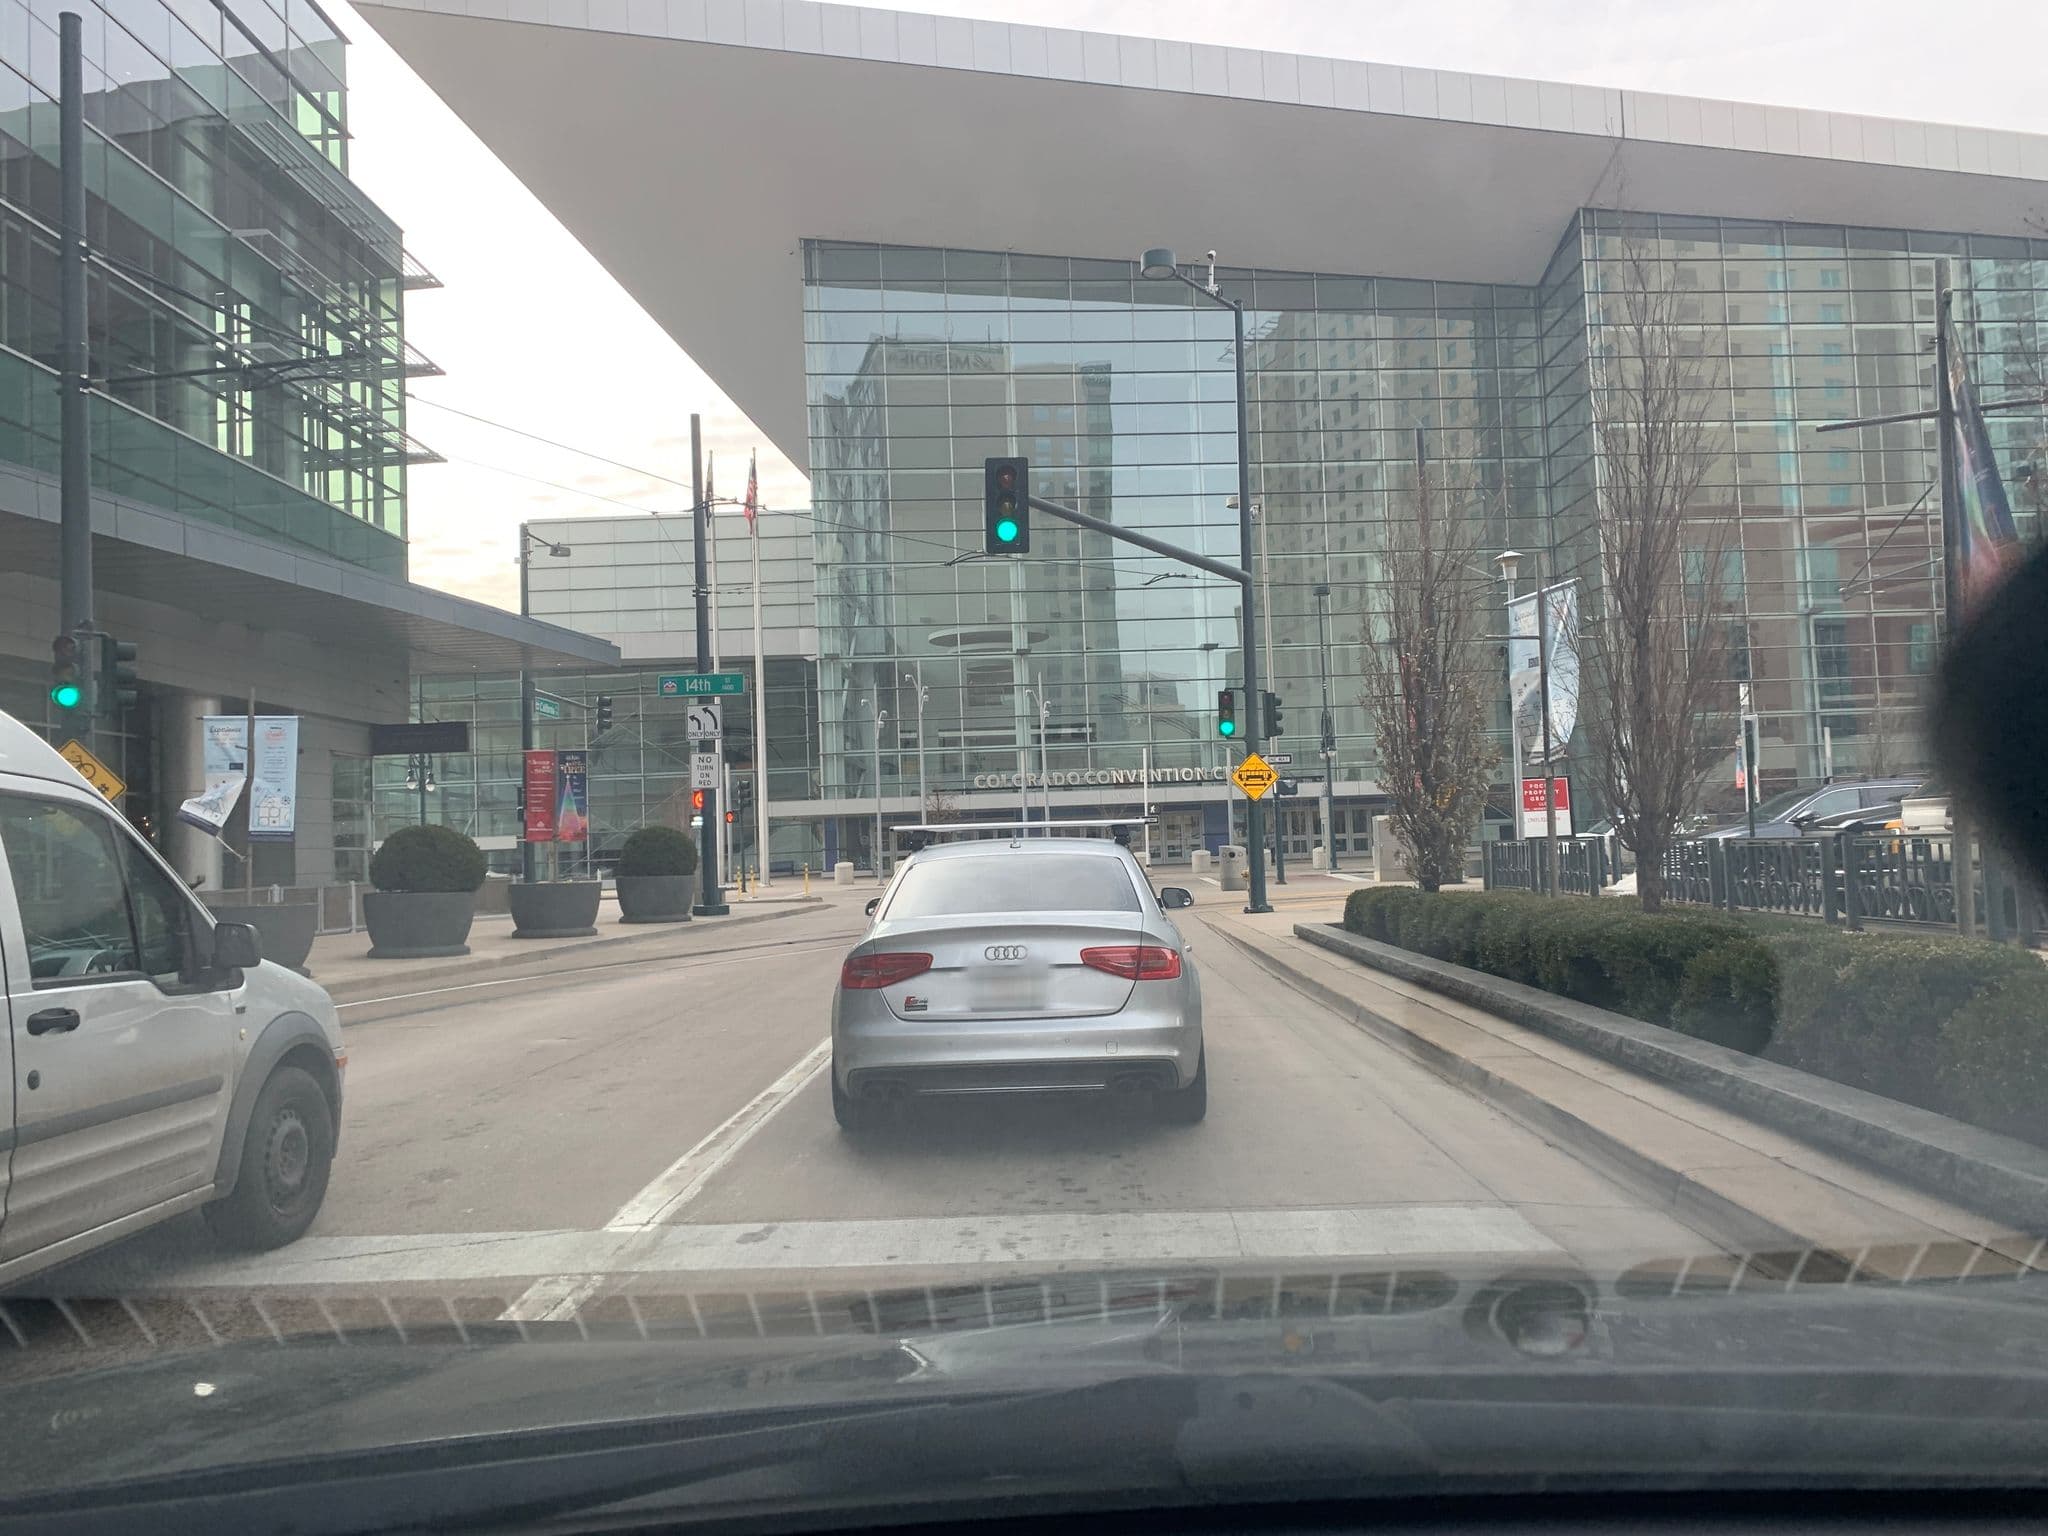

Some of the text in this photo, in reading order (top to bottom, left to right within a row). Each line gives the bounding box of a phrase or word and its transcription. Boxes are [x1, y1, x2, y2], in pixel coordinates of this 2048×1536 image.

[685, 678, 711, 692] 14th
[974, 770, 1080, 788] COLORADO
[1085, 766, 1207, 785] CONVENTION
